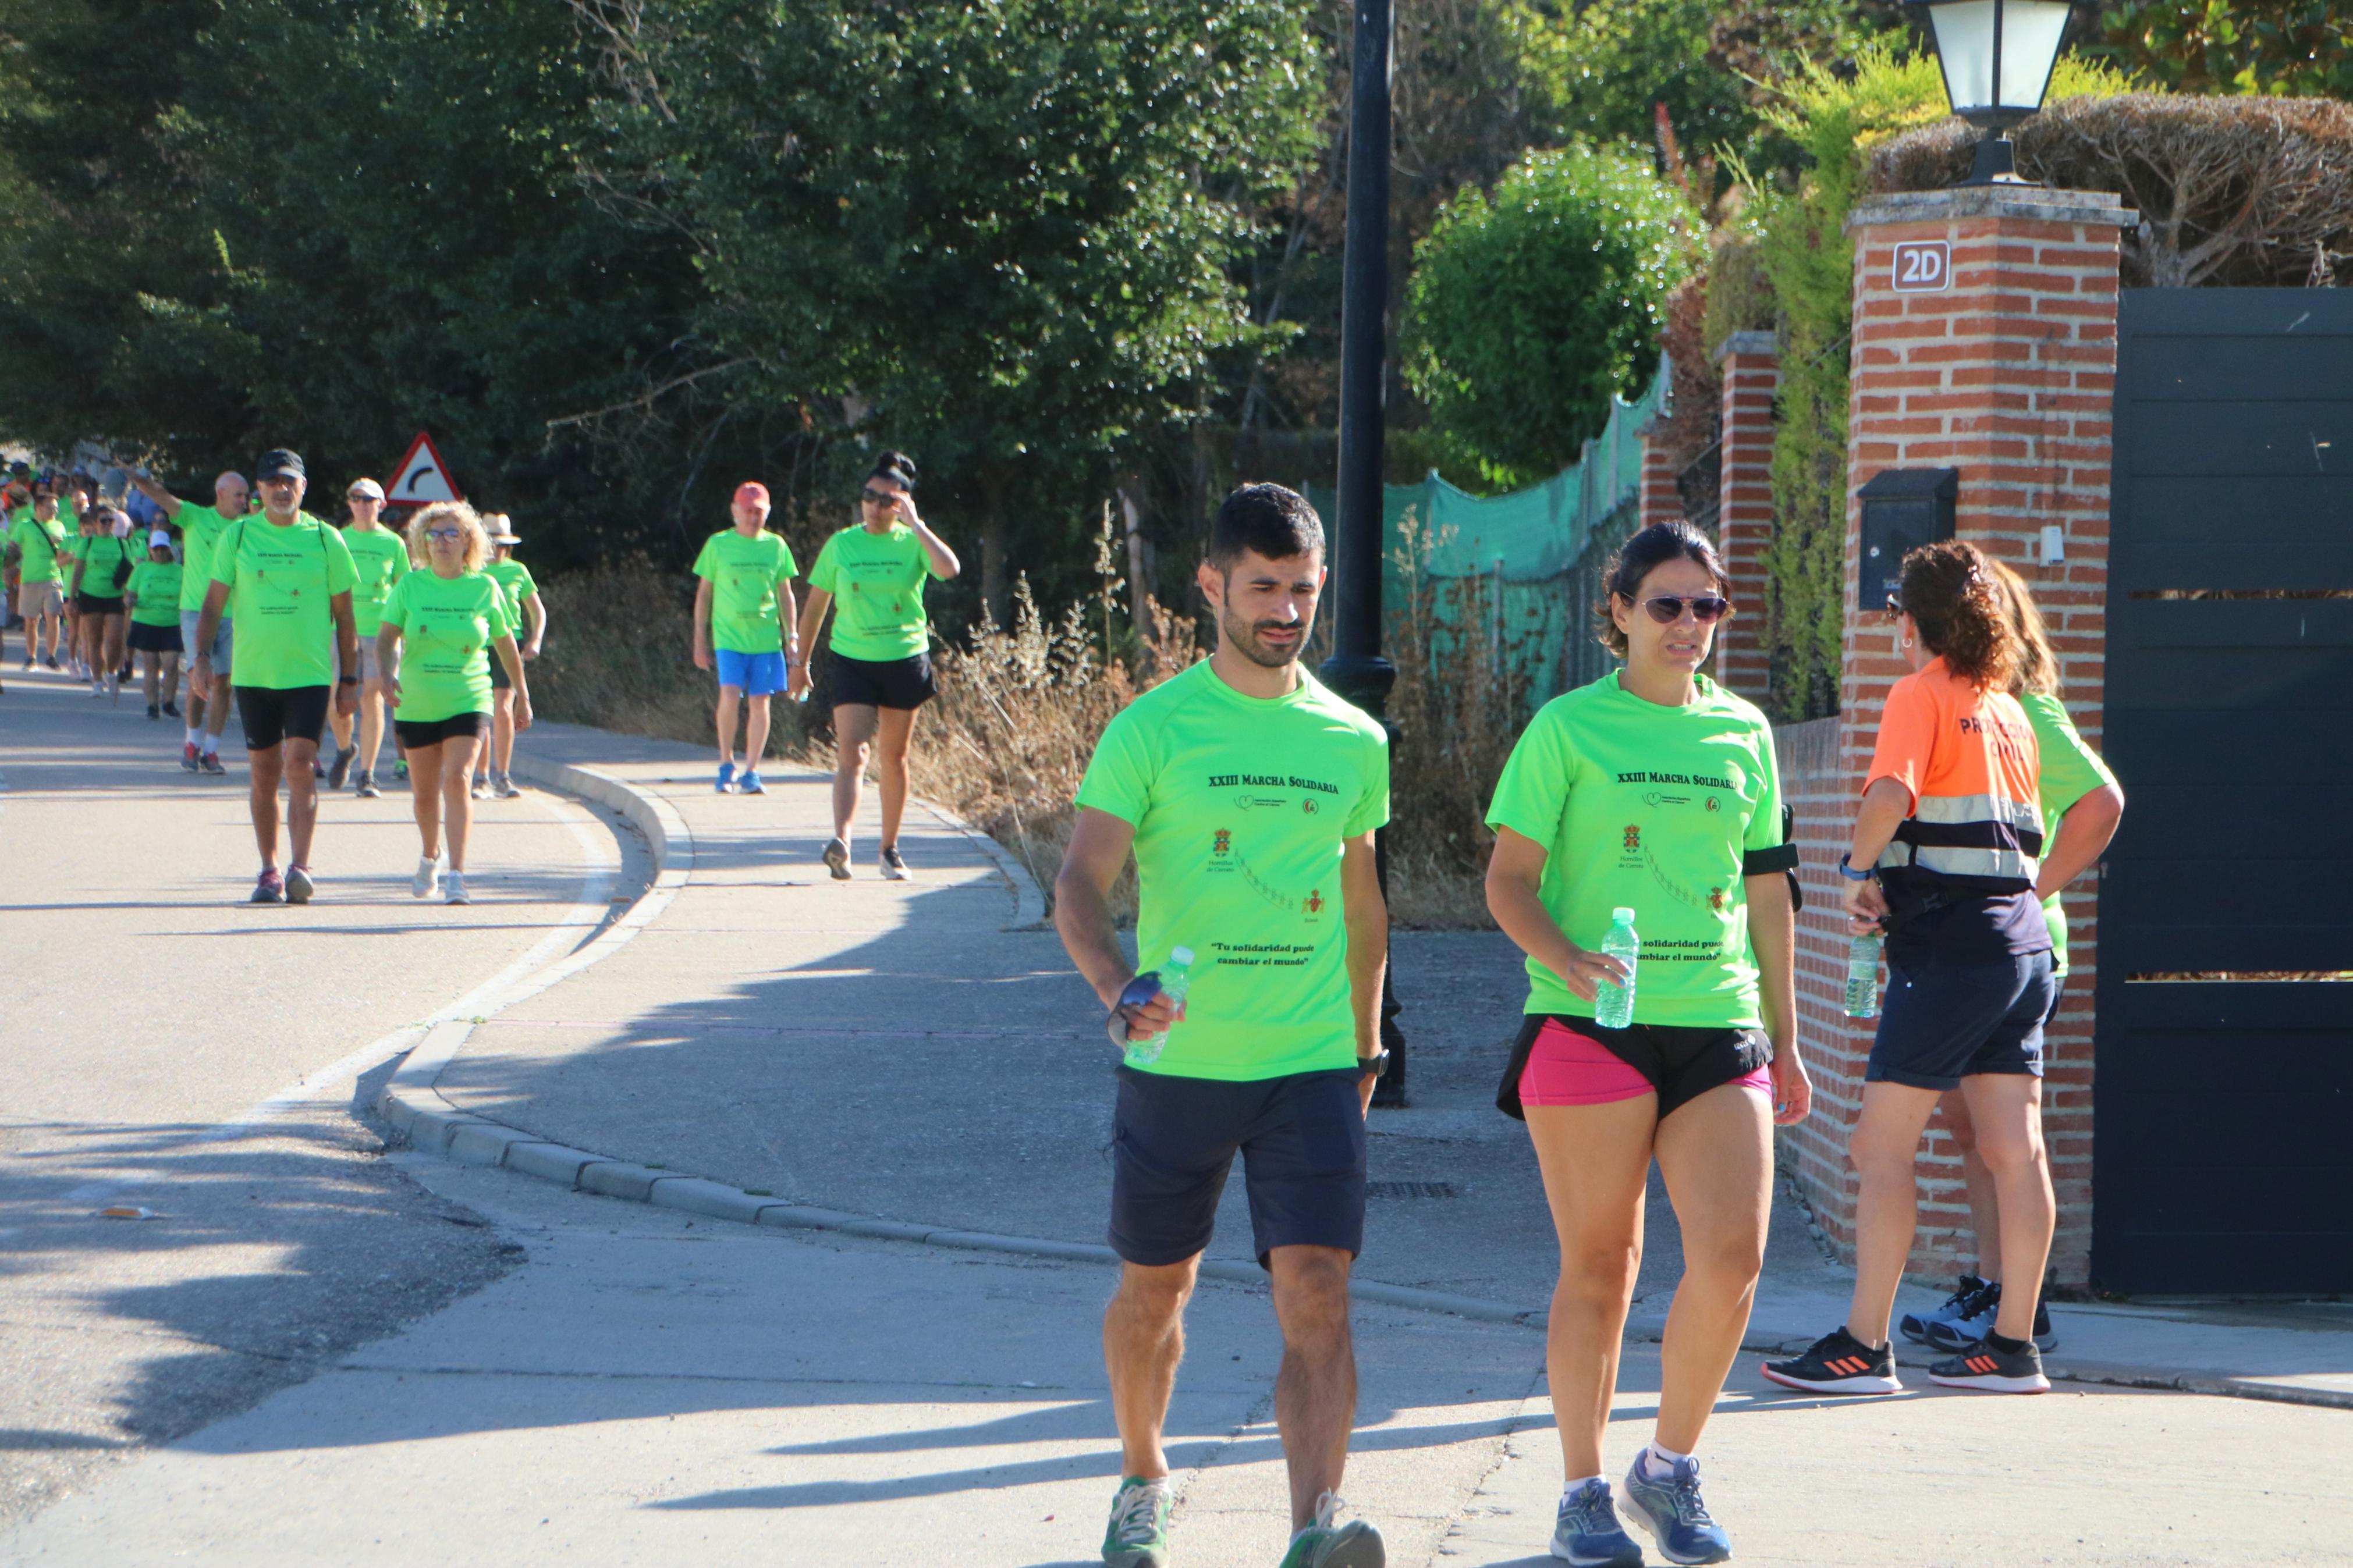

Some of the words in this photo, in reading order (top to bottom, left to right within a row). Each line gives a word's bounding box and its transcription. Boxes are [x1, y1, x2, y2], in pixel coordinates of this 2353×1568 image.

[1902, 249, 1942, 282] 2D
[1208, 774, 1239, 787] XXIII
[1242, 774, 1286, 787] MARCHA
[1289, 776, 1339, 794] SOLIDARIA
[1617, 772, 1646, 783] XXIII
[1649, 771, 1691, 784] MARCHA
[1692, 774, 1739, 790] SOLIDARIA
[1233, 944, 1291, 952] solidaridad
[1293, 944, 1315, 954] puede
[1643, 940, 1699, 948] solidaridad
[1217, 958, 1260, 966] cambiar
[1262, 958, 1272, 966] el
[1637, 953, 1670, 961] mbiar
[1672, 953, 1681, 961] el
